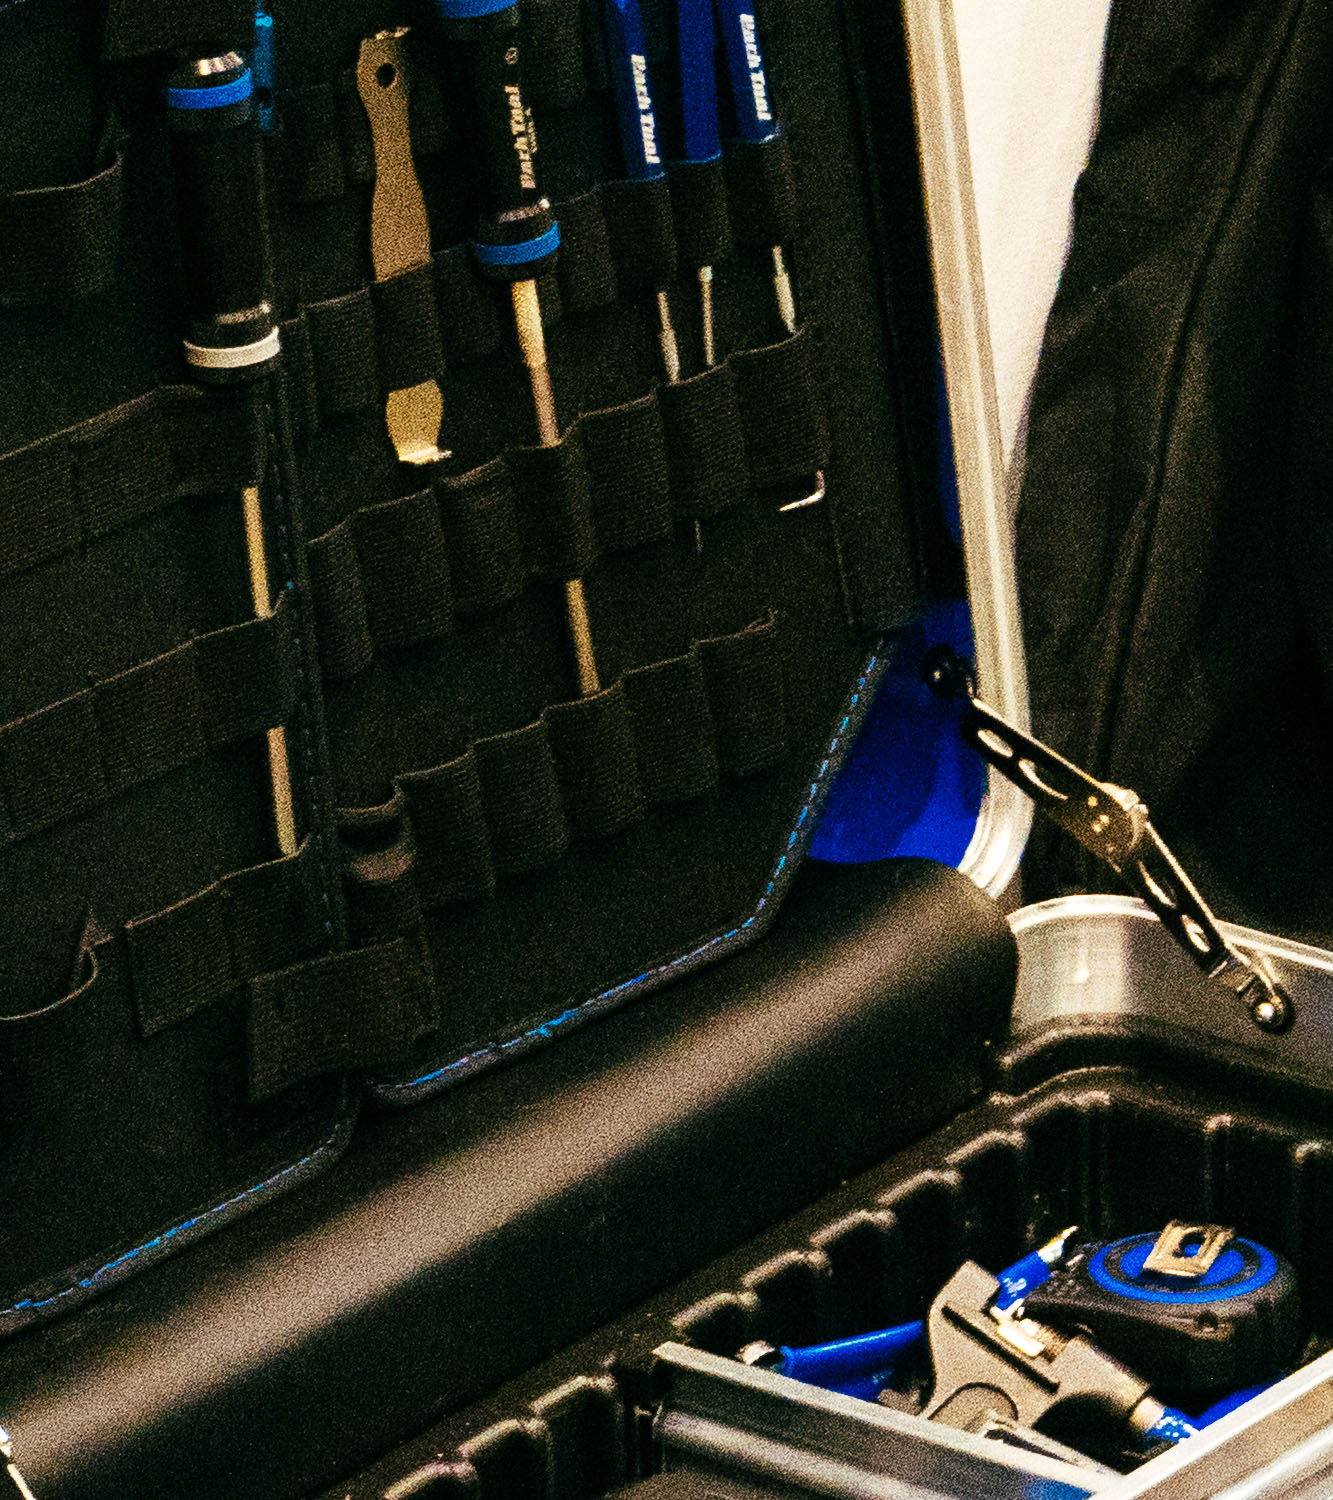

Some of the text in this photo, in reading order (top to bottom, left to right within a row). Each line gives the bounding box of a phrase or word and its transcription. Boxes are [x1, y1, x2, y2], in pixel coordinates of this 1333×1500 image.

[739, 13, 774, 122] Park Tool
[503, 84, 526, 136] Tool
[630, 53, 662, 165] Park Tool
[513, 136, 537, 190] Park
